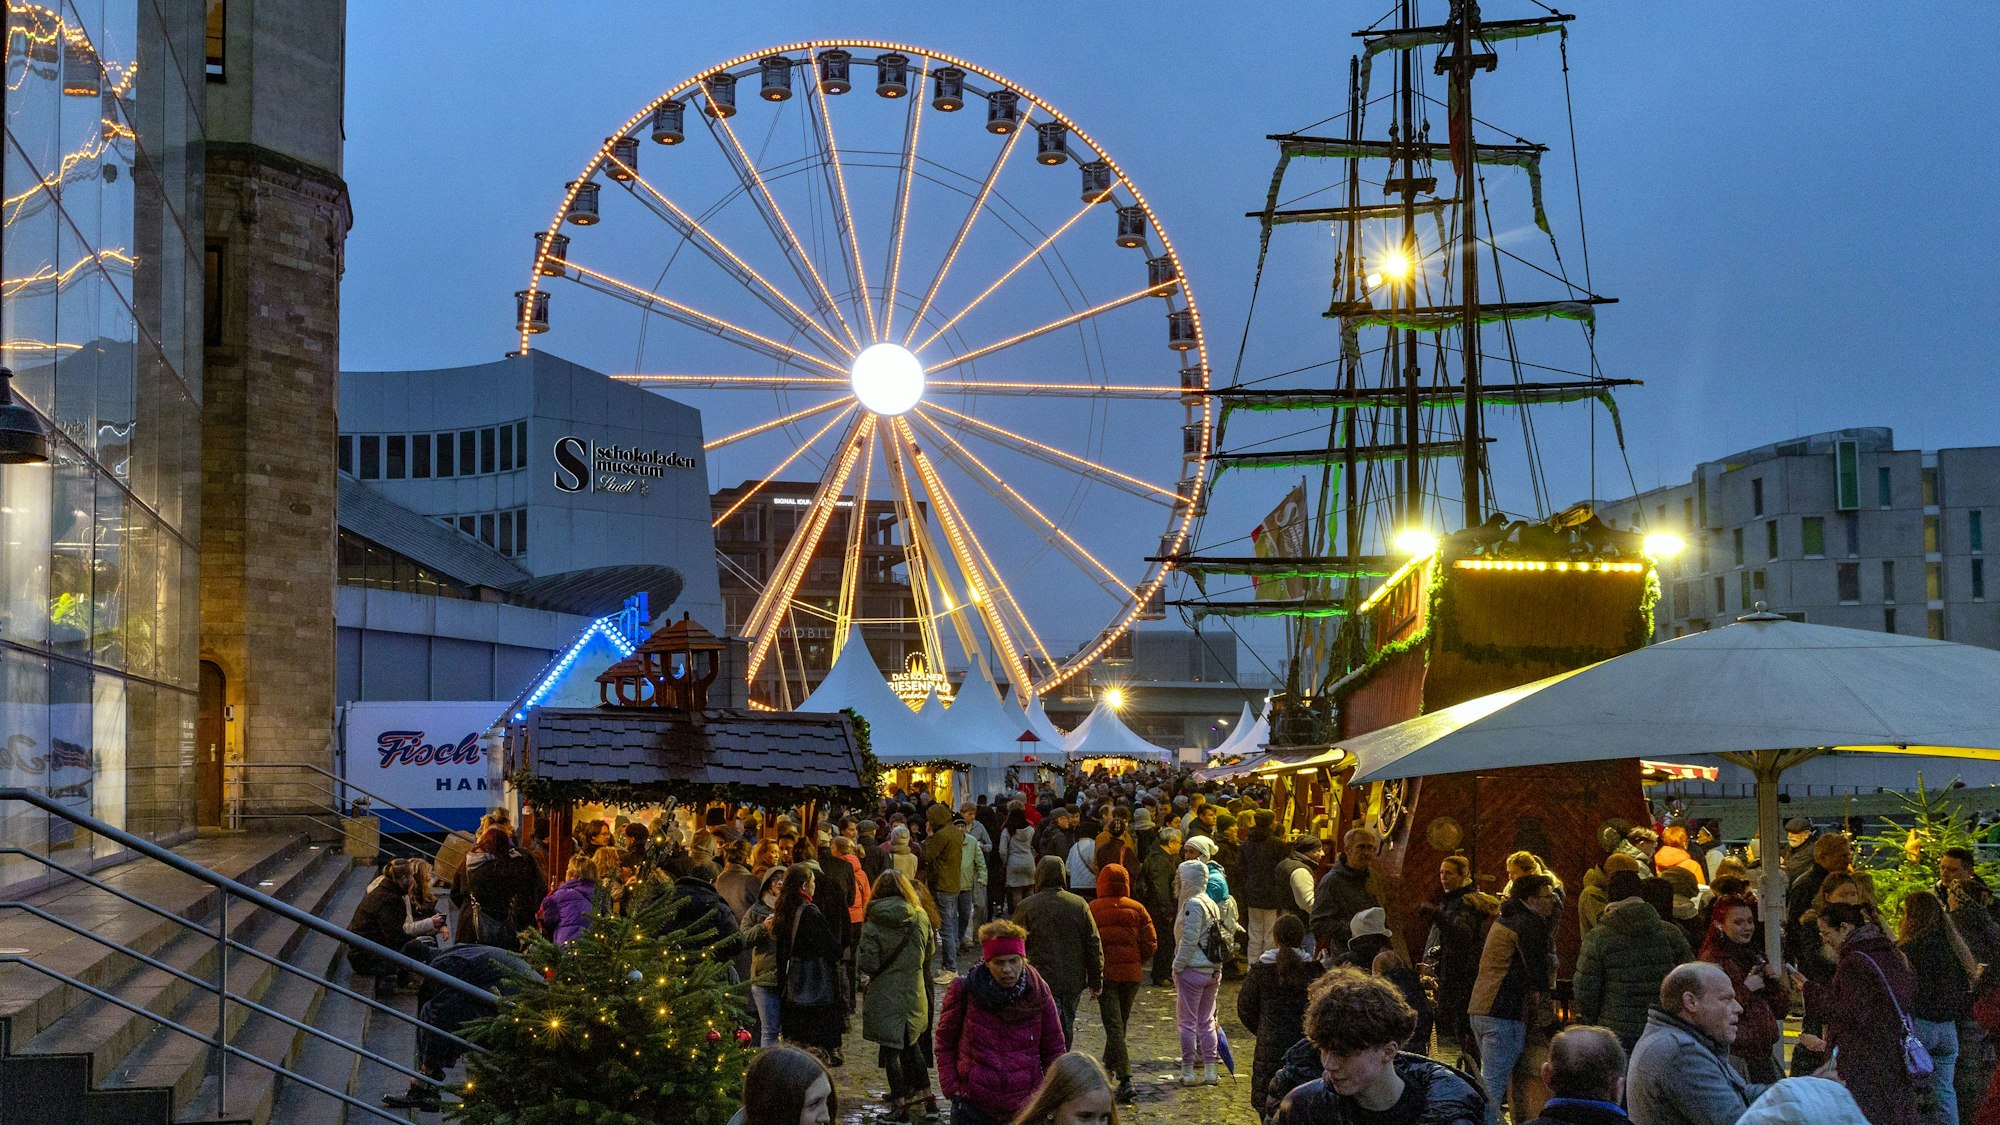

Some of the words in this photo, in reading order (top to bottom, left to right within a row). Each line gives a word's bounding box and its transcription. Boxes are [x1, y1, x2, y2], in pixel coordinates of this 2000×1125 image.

[595, 444, 696, 469] schokoladen
[595, 460, 664, 478] museum
[597, 475, 636, 495] Lindt
[892, 673, 909, 681] DAS
